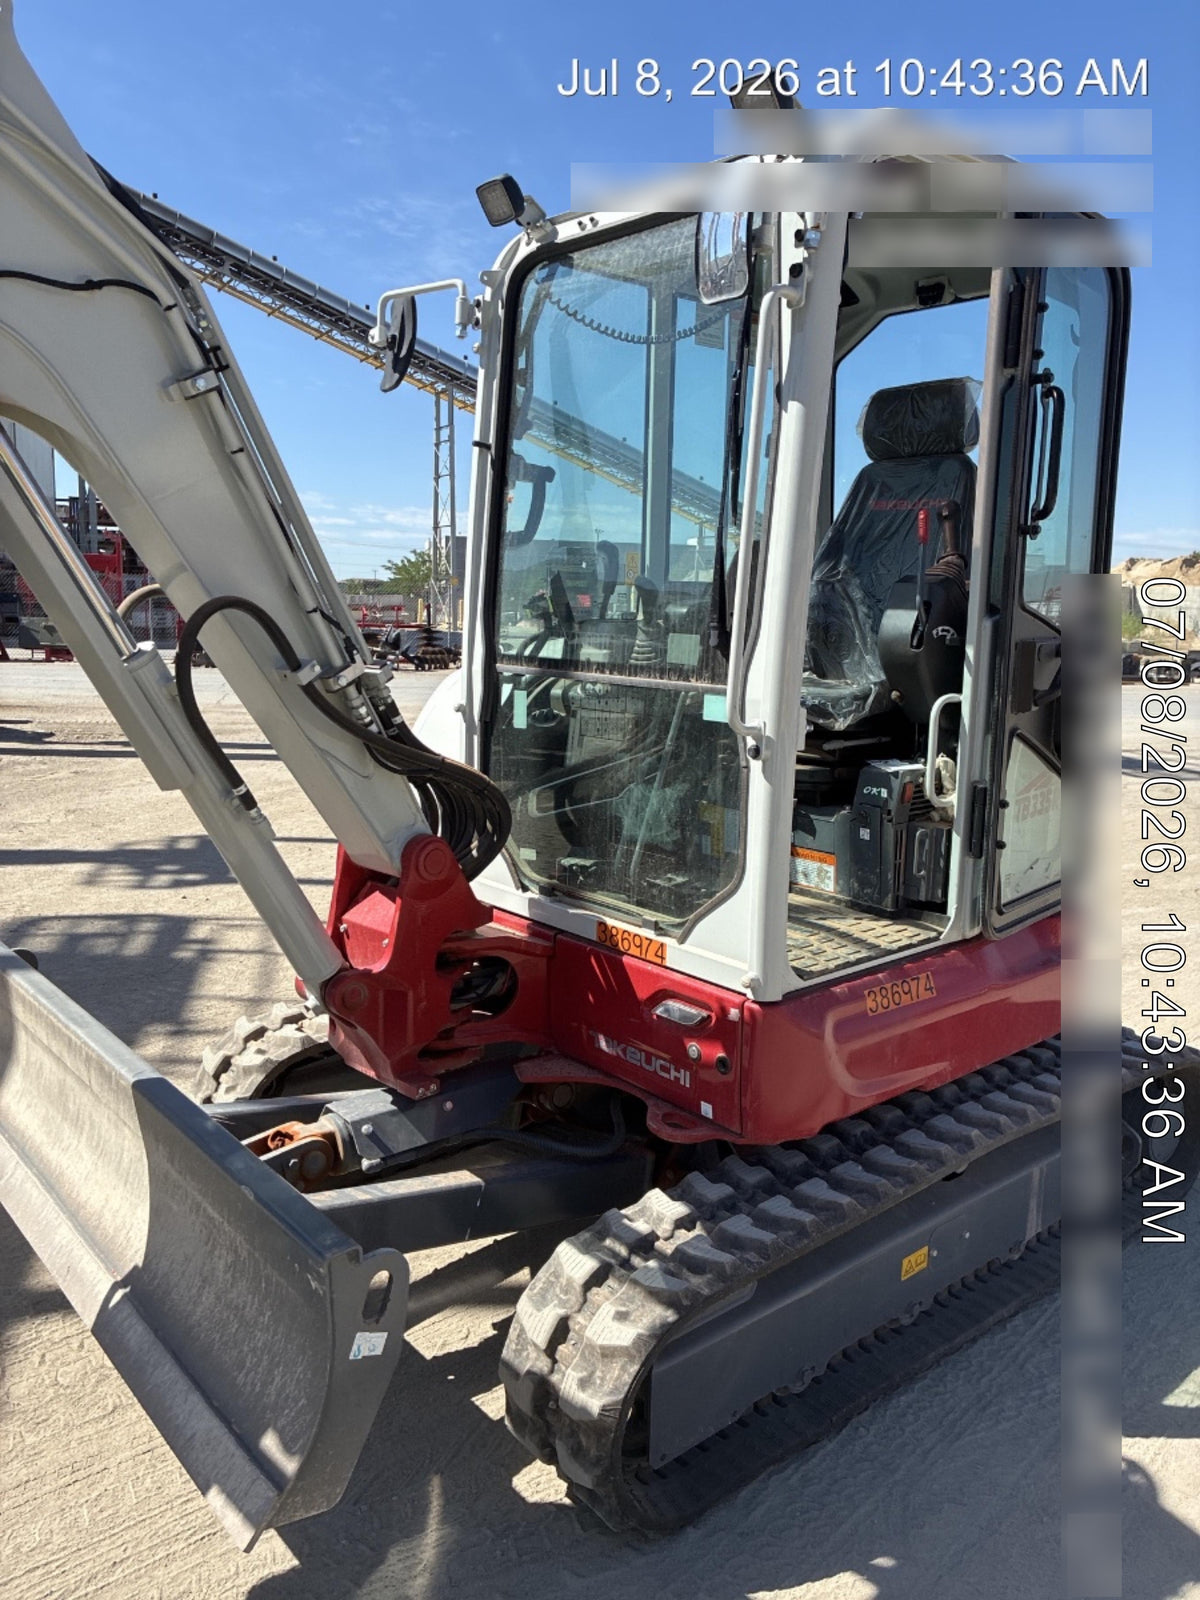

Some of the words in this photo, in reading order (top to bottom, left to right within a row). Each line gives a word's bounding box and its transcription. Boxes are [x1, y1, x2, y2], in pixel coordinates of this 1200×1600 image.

[597, 921, 666, 965] 386974
[867, 972, 934, 1014] 386974
[588, 1030, 691, 1089] TAKEUCHI
